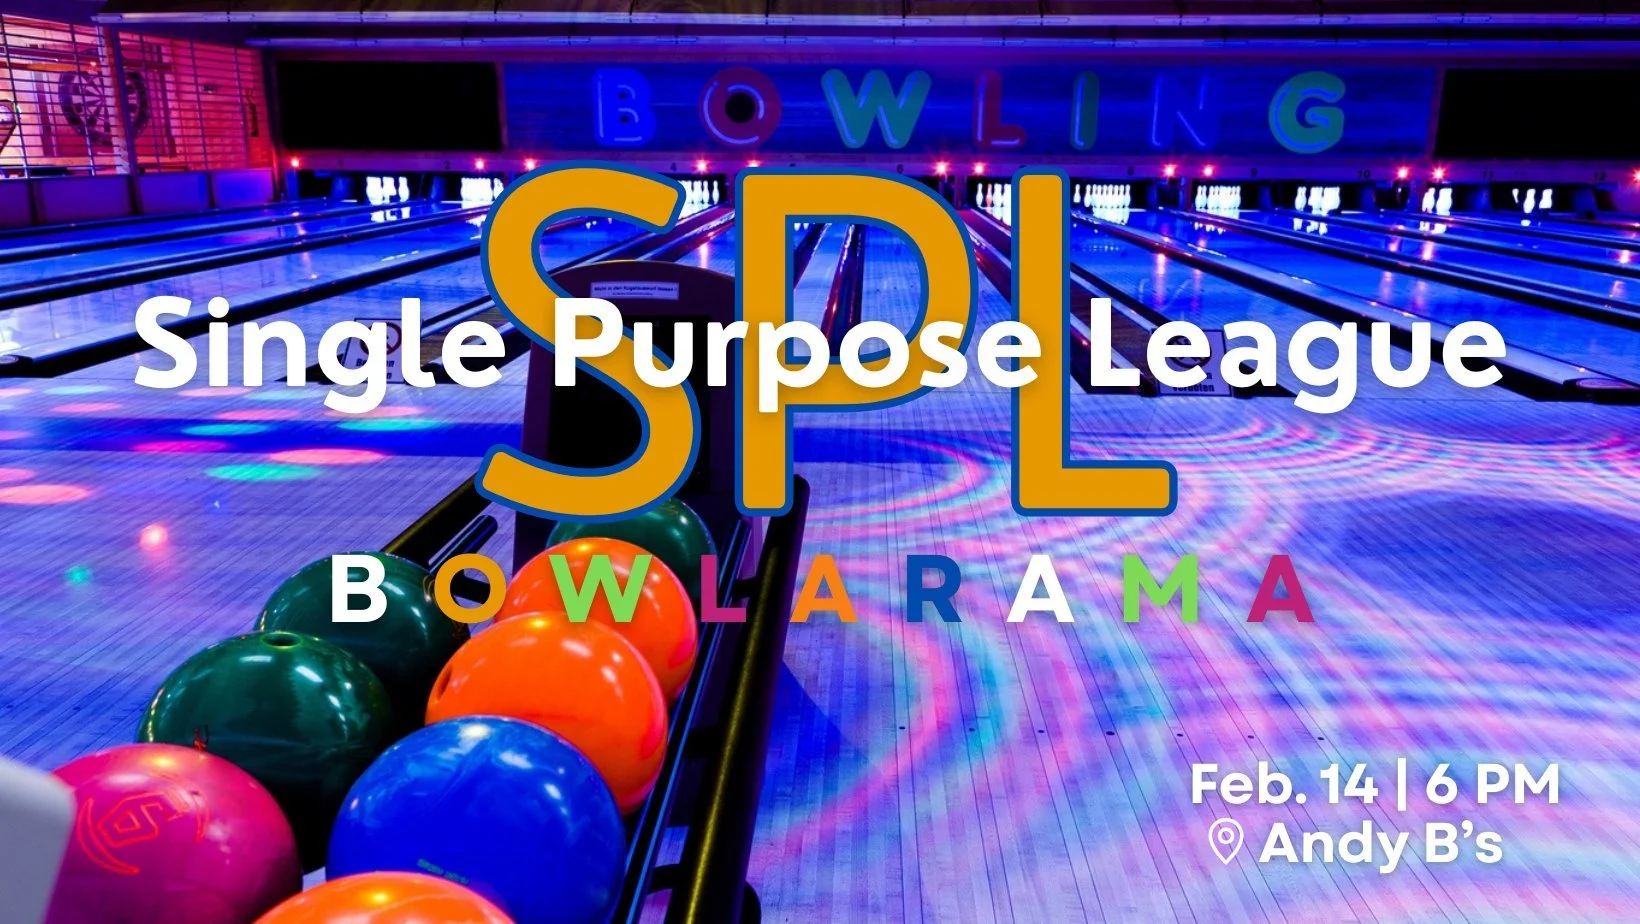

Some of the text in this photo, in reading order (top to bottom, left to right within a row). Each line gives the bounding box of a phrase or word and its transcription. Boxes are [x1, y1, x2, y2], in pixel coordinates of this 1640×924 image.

[592, 66, 1346, 155] BOWLING
[670, 162, 677, 171] 4
[1357, 169, 1370, 179] 10
